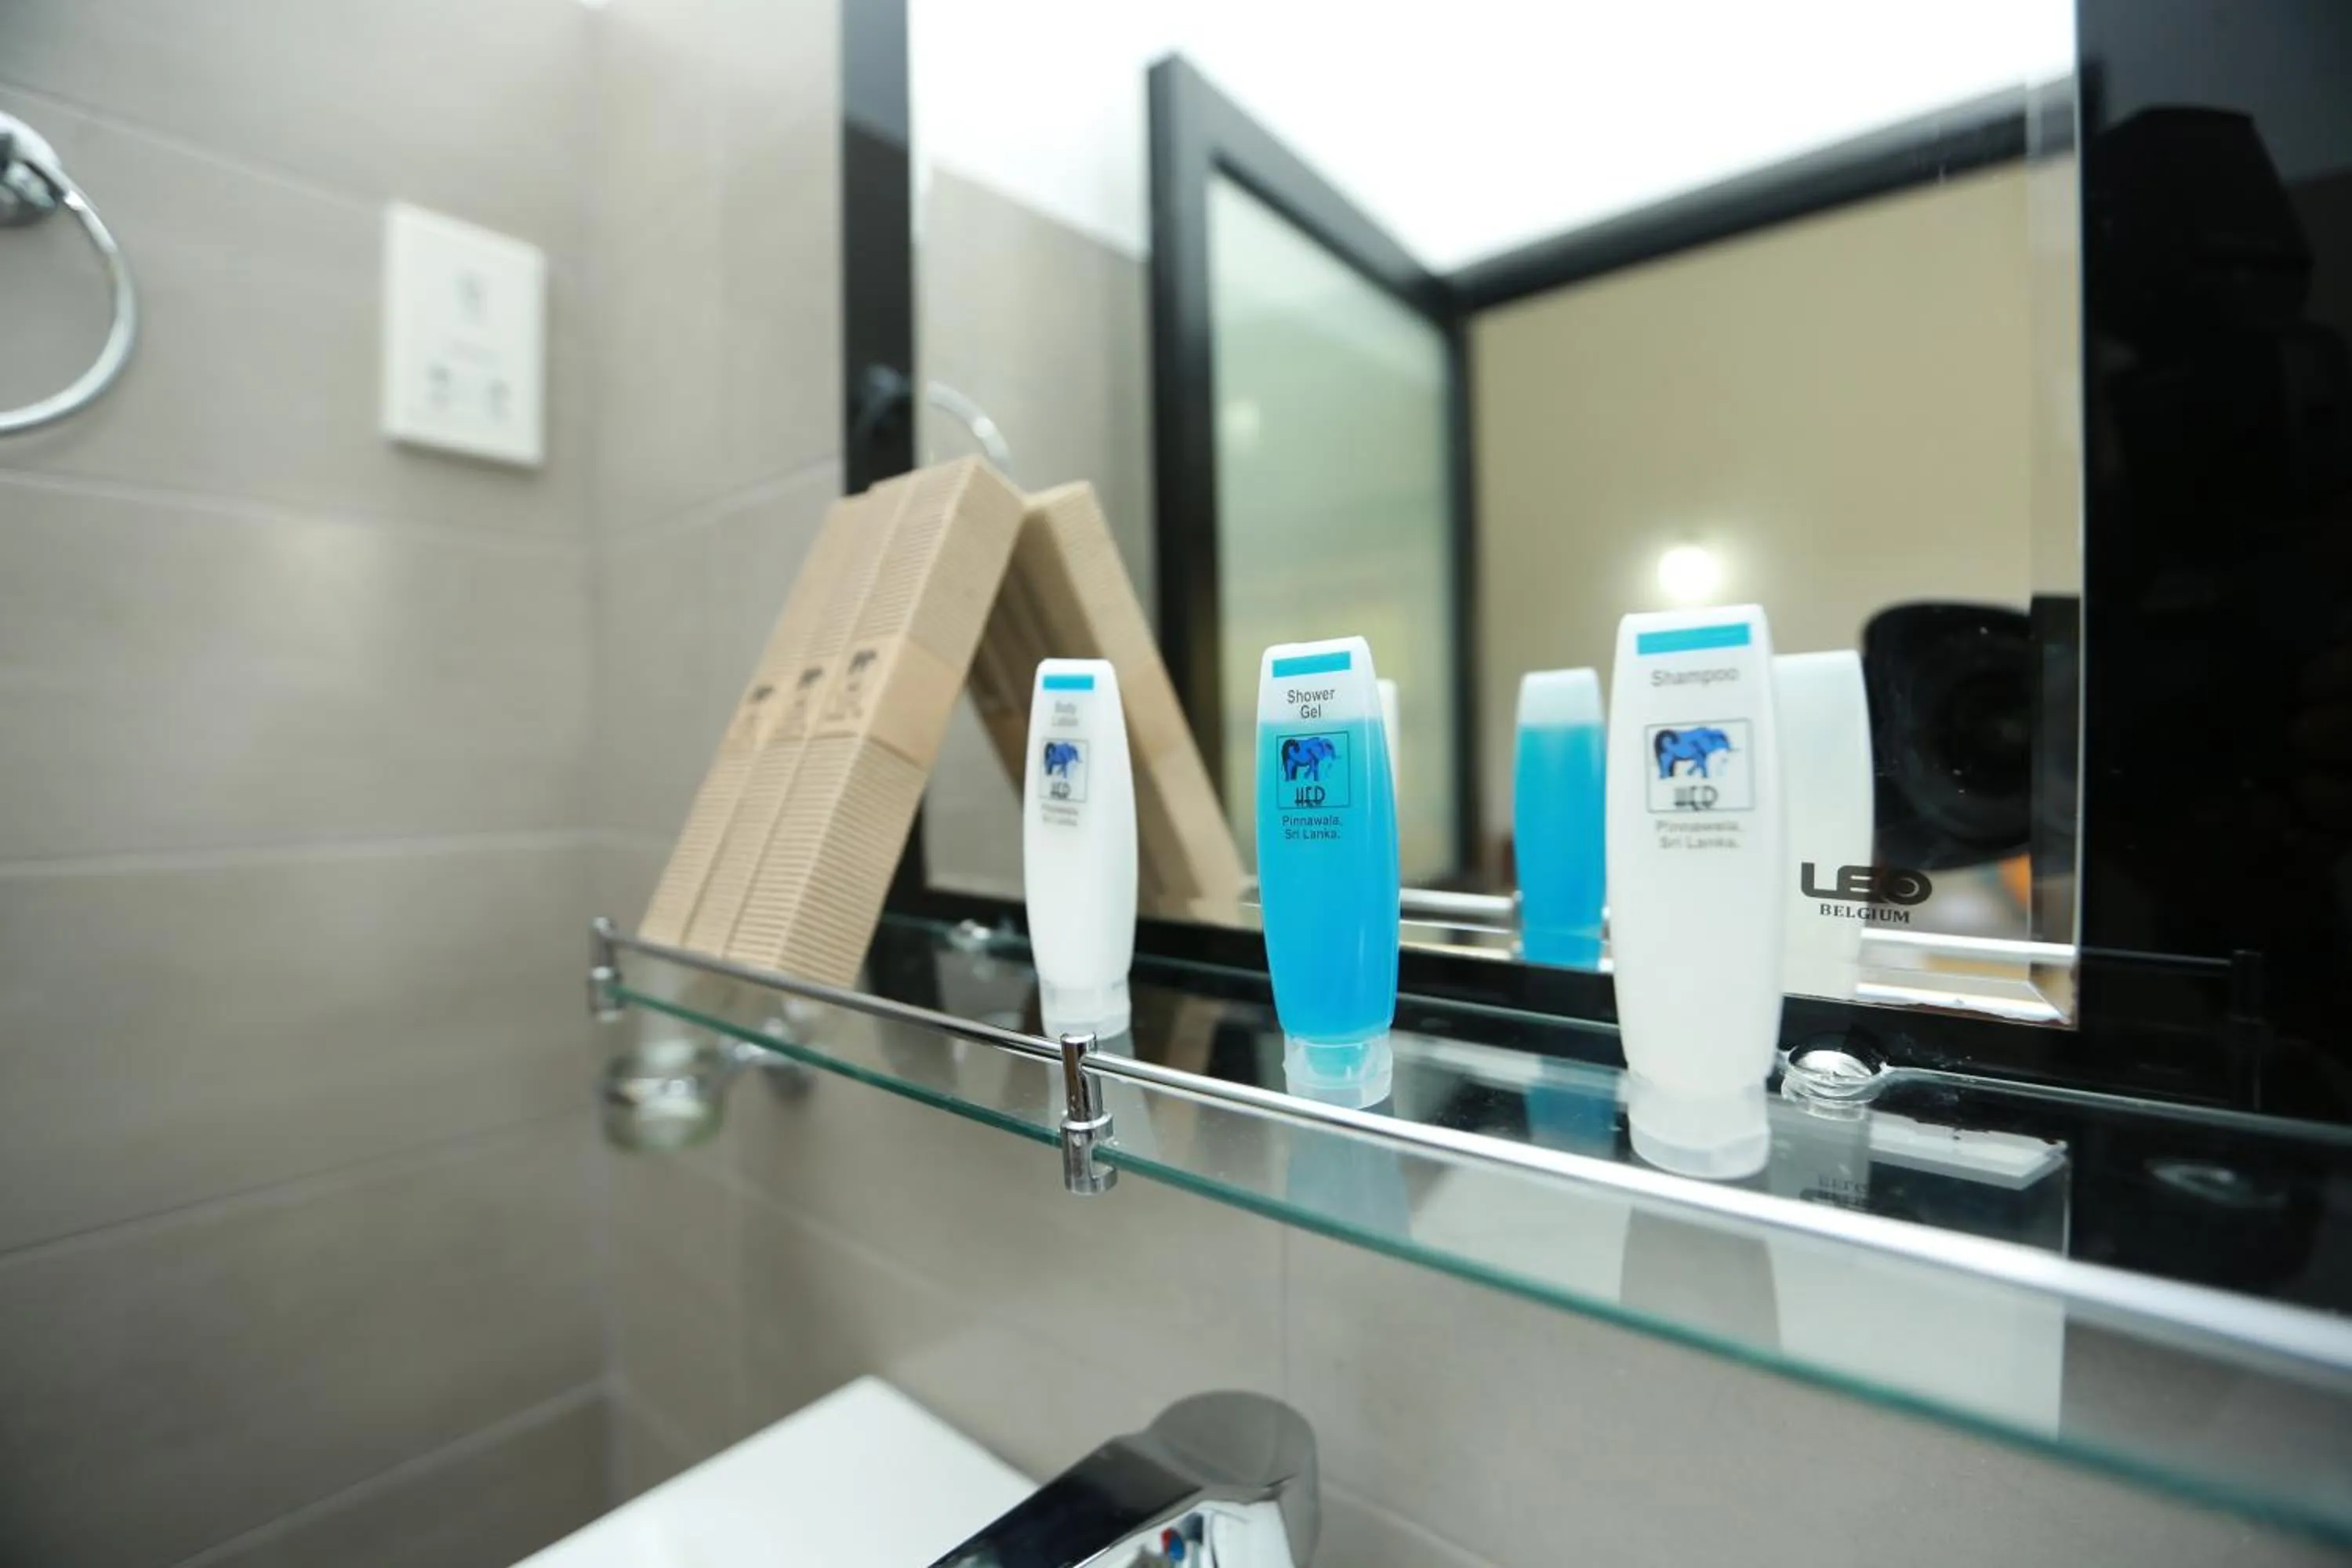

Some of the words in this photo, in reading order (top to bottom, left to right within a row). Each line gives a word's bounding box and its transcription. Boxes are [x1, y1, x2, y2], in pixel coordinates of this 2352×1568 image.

[1650, 668, 1740, 688] Shampoo
[1287, 689, 1335, 703] Shower
[1300, 704, 1322, 718] Gel
[1285, 828, 1300, 840] Sri
[1801, 862, 1933, 906] LEO
[1820, 903, 1910, 924] BELGIUM
